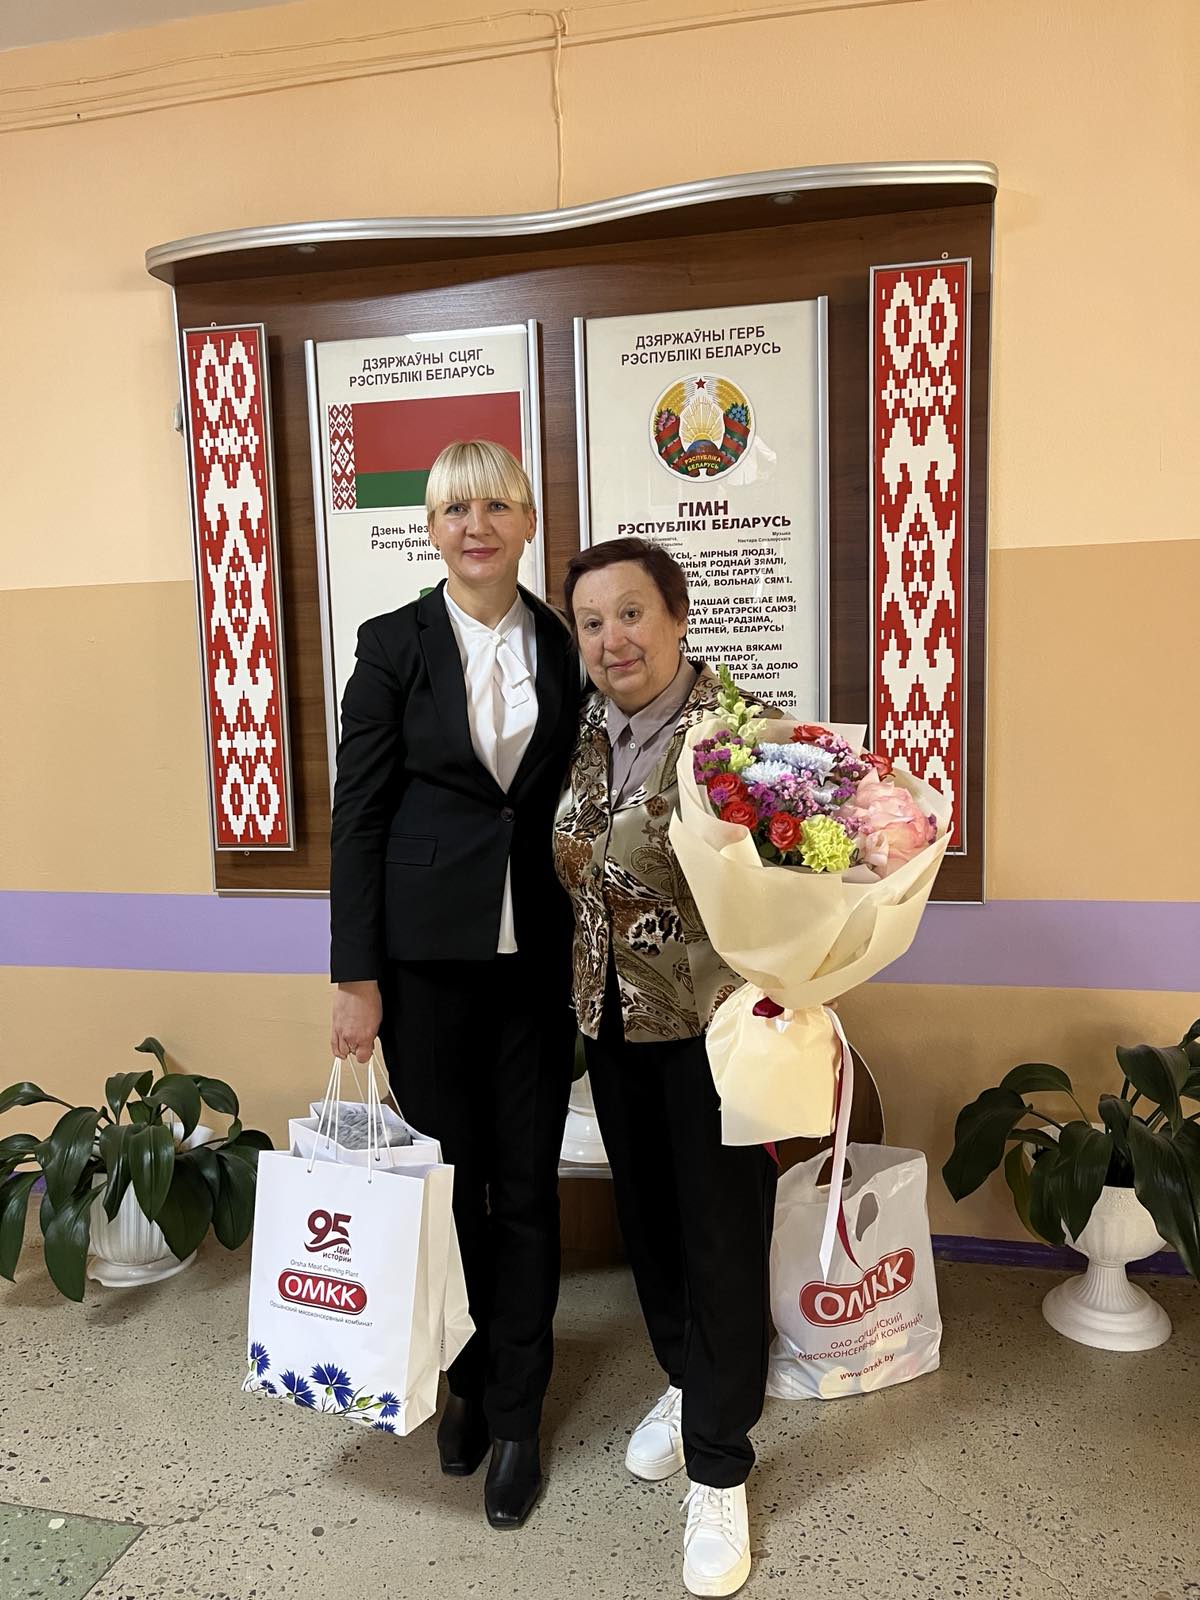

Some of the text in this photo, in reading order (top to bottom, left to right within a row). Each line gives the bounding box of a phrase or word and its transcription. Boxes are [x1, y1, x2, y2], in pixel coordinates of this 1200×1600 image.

[636, 325, 765, 350] ДЗЯРЖАЎНЫ ГЕРБ
[621, 342, 782, 366] РЭСПУБЛІКІ БЕЛАРУСЬ
[362, 348, 484, 373] ДЗЯРЖАЎНЫ СЦЯГ
[349, 364, 495, 387] РЭСПУБЛІКІ БЕЛАРУСЬ
[684, 454, 721, 465] РЭСПУБЛІКА
[687, 462, 719, 471] БЕЛАРУСЬ
[678, 500, 729, 518] ГІМН
[371, 523, 429, 538] Дзень Нез
[618, 516, 792, 535] РЭСПУБЛІКІ БЕЛАРУСЬ
[371, 537, 431, 550] Рэспублікі
[407, 550, 441, 561] 3 ліпе
[670, 548, 777, 560] УСЫ,- МІРНЫЯ ЛЮДЗІ,
[680, 557, 787, 568] АНЫЯ РОДНАЙ ЗЯМЛІ,
[705, 569, 730, 577] СІЛЫ
[732, 567, 774, 576] ГАРТУЕМ
[714, 576, 761, 587] ВОЛЬНАЙ
[693, 597, 730, 606] НАШАЙ
[776, 595, 797, 604] ІМЯ,
[688, 604, 797, 617] ДАЎ БРАТЭРСКІ САЮЗ!
[699, 615, 773, 625] МАЦІ-РАДЗІМА,
[688, 624, 785, 635] КВІТНЕЙ, БЕЛАРУСЬ!
[705, 645, 743, 653] МУЖНА
[746, 643, 783, 652] ВЯКАМІ
[723, 654, 758, 662] ПАРОГ,
[751, 663, 764, 671] ЗА
[766, 662, 799, 671] ДОЛЮ
[733, 672, 780, 680] ПЕРАМОГ!
[776, 690, 797, 699] ІМЯ,
[307, 1209, 352, 1245] 95
[322, 1252, 352, 1263] истории
[290, 1259, 307, 1268] Orsha
[308, 1262, 323, 1270] Meat
[345, 1269, 359, 1278] Plant
[285, 1275, 357, 1309] ОМКК
[814, 1257, 907, 1321] ОМКК
[830, 1339, 853, 1350] ОАО
